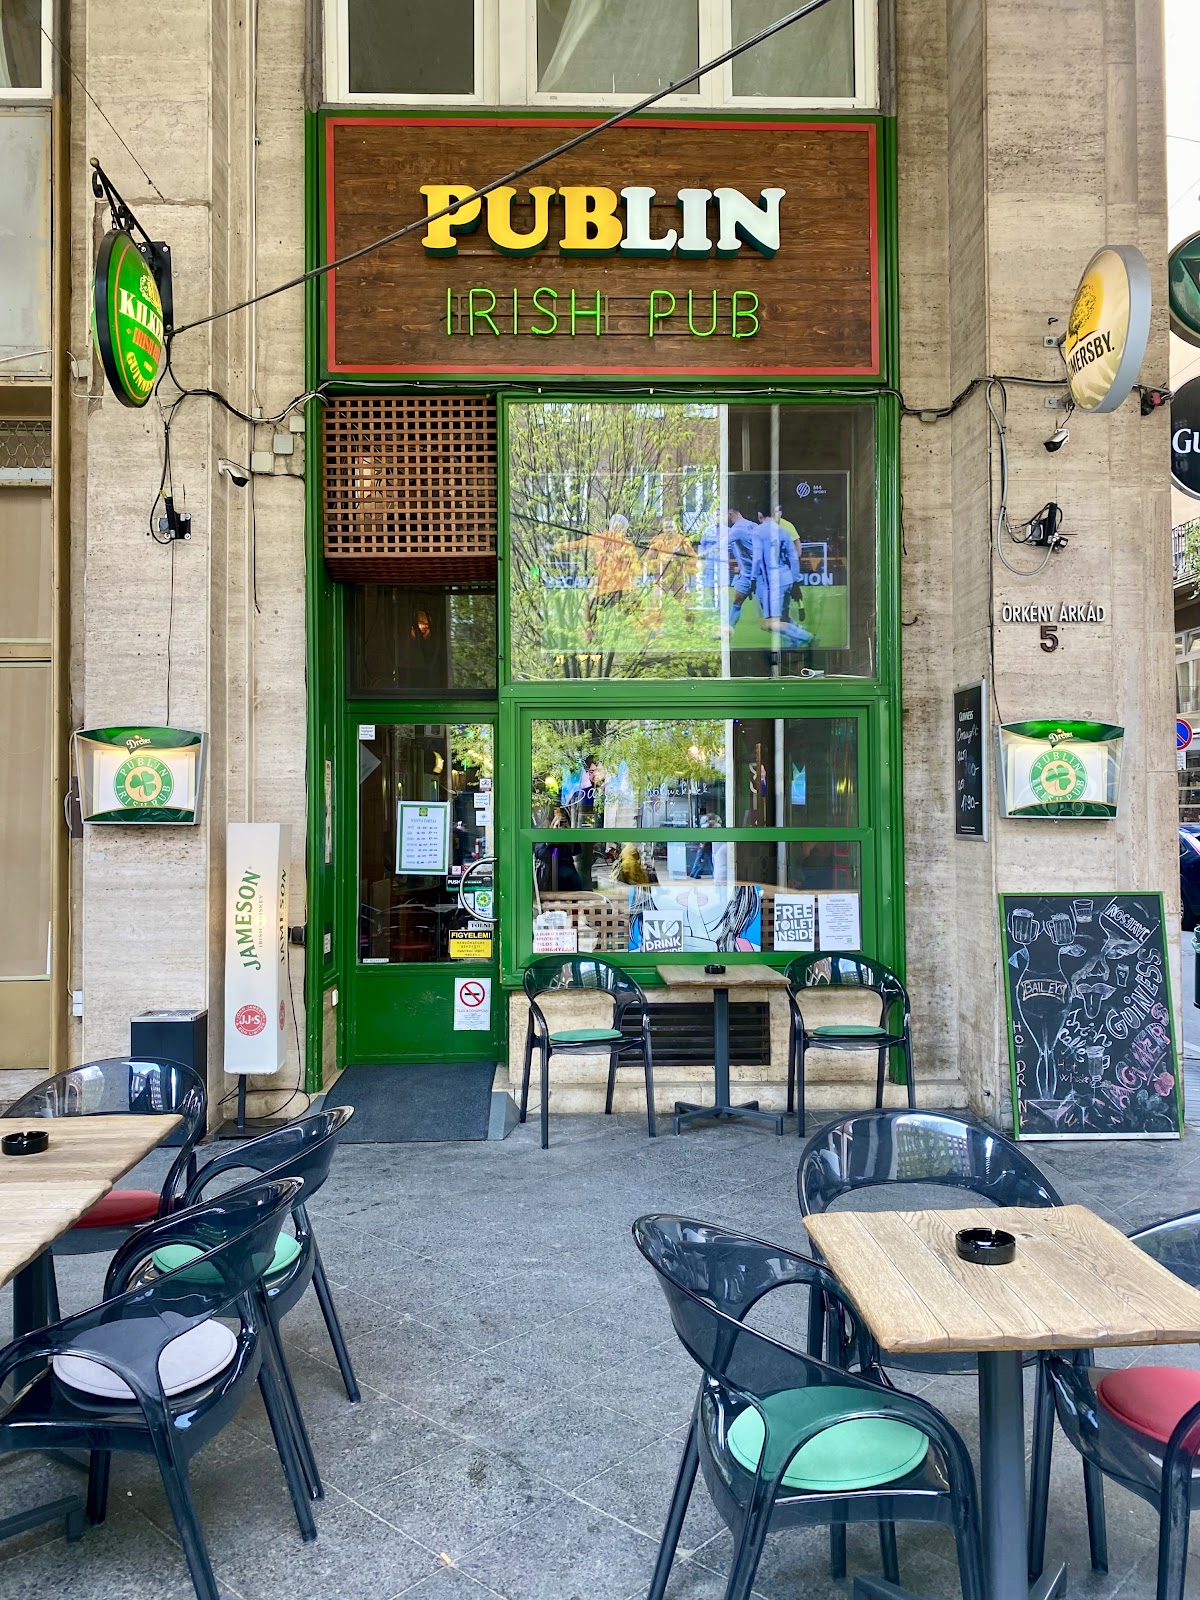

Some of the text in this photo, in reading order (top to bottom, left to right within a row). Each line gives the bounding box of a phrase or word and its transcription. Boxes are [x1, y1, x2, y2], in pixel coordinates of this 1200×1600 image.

[419, 184, 787, 258] PUBLIN
[119, 288, 163, 346] KILKE
[446, 287, 761, 338] IRISH PUB
[1068, 331, 1116, 379] MERSBY.
[1002, 601, 1106, 622] ÖRKÉNY ÁRKÁD
[1040, 625, 1059, 652] 5
[120, 757, 168, 777] PUBLIN
[1035, 751, 1082, 771] PUBLIN
[151, 785, 171, 806] PUB
[1066, 780, 1085, 801] PUB
[235, 870, 261, 971] JAMESON
[279, 868, 287, 966] JAMESON
[775, 904, 812, 920] FREE
[1105, 903, 1151, 942] JAMESON
[451, 931, 491, 939] FIGYELEM!
[775, 919, 813, 931] TOILET
[775, 929, 813, 942] INSIDE
[646, 936, 682, 951] DRINK
[1013, 1020, 1028, 1128] HOT DRINK
